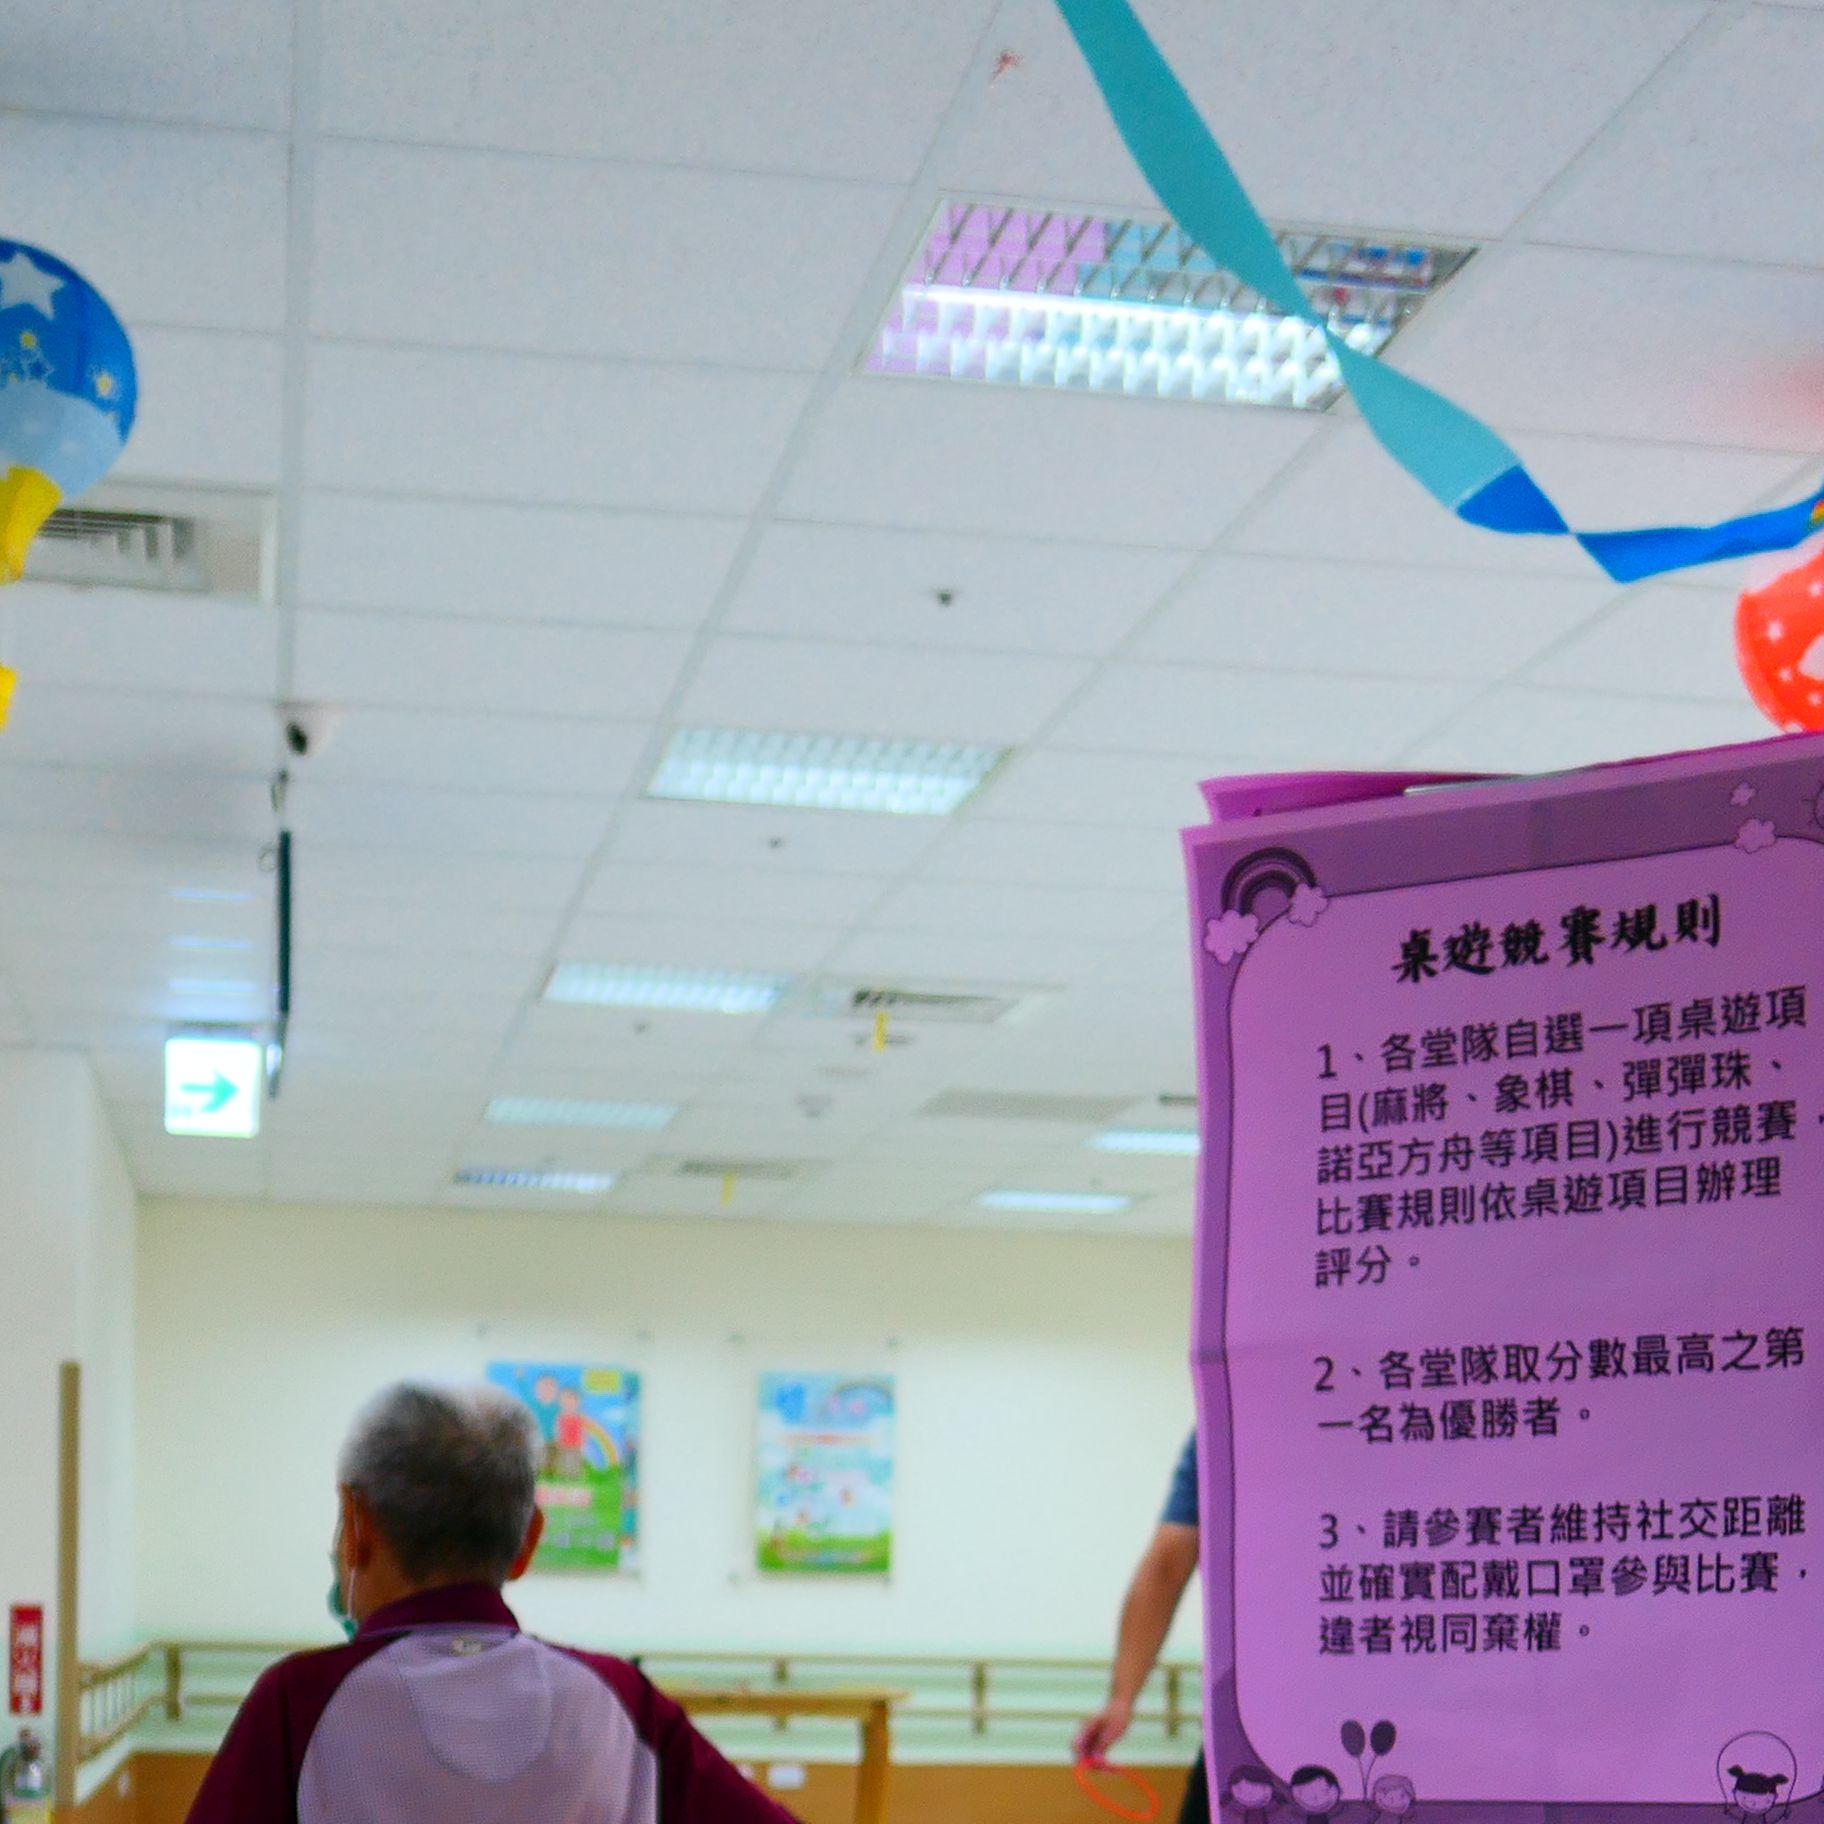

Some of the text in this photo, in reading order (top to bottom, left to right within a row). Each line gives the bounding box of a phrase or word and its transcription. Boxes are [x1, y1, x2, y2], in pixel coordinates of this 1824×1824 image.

[1391, 892, 1721, 984] 桌遊競賽規則
[1317, 985, 1807, 1079] 1、各堂隊自選一項桌遊項
[1316, 1156, 1782, 1236] 比賽規則依桌遊項目辦理
[1315, 1245, 1421, 1288] 評分。
[1313, 1327, 1806, 1392] 2、各堂隊取分數最高之第
[1317, 1396, 1590, 1443] 一名為優勝者。
[1318, 1493, 1806, 1550] 3、請參賽者維持社交距離
[1318, 1611, 1590, 1655] 違者視同棄權。
